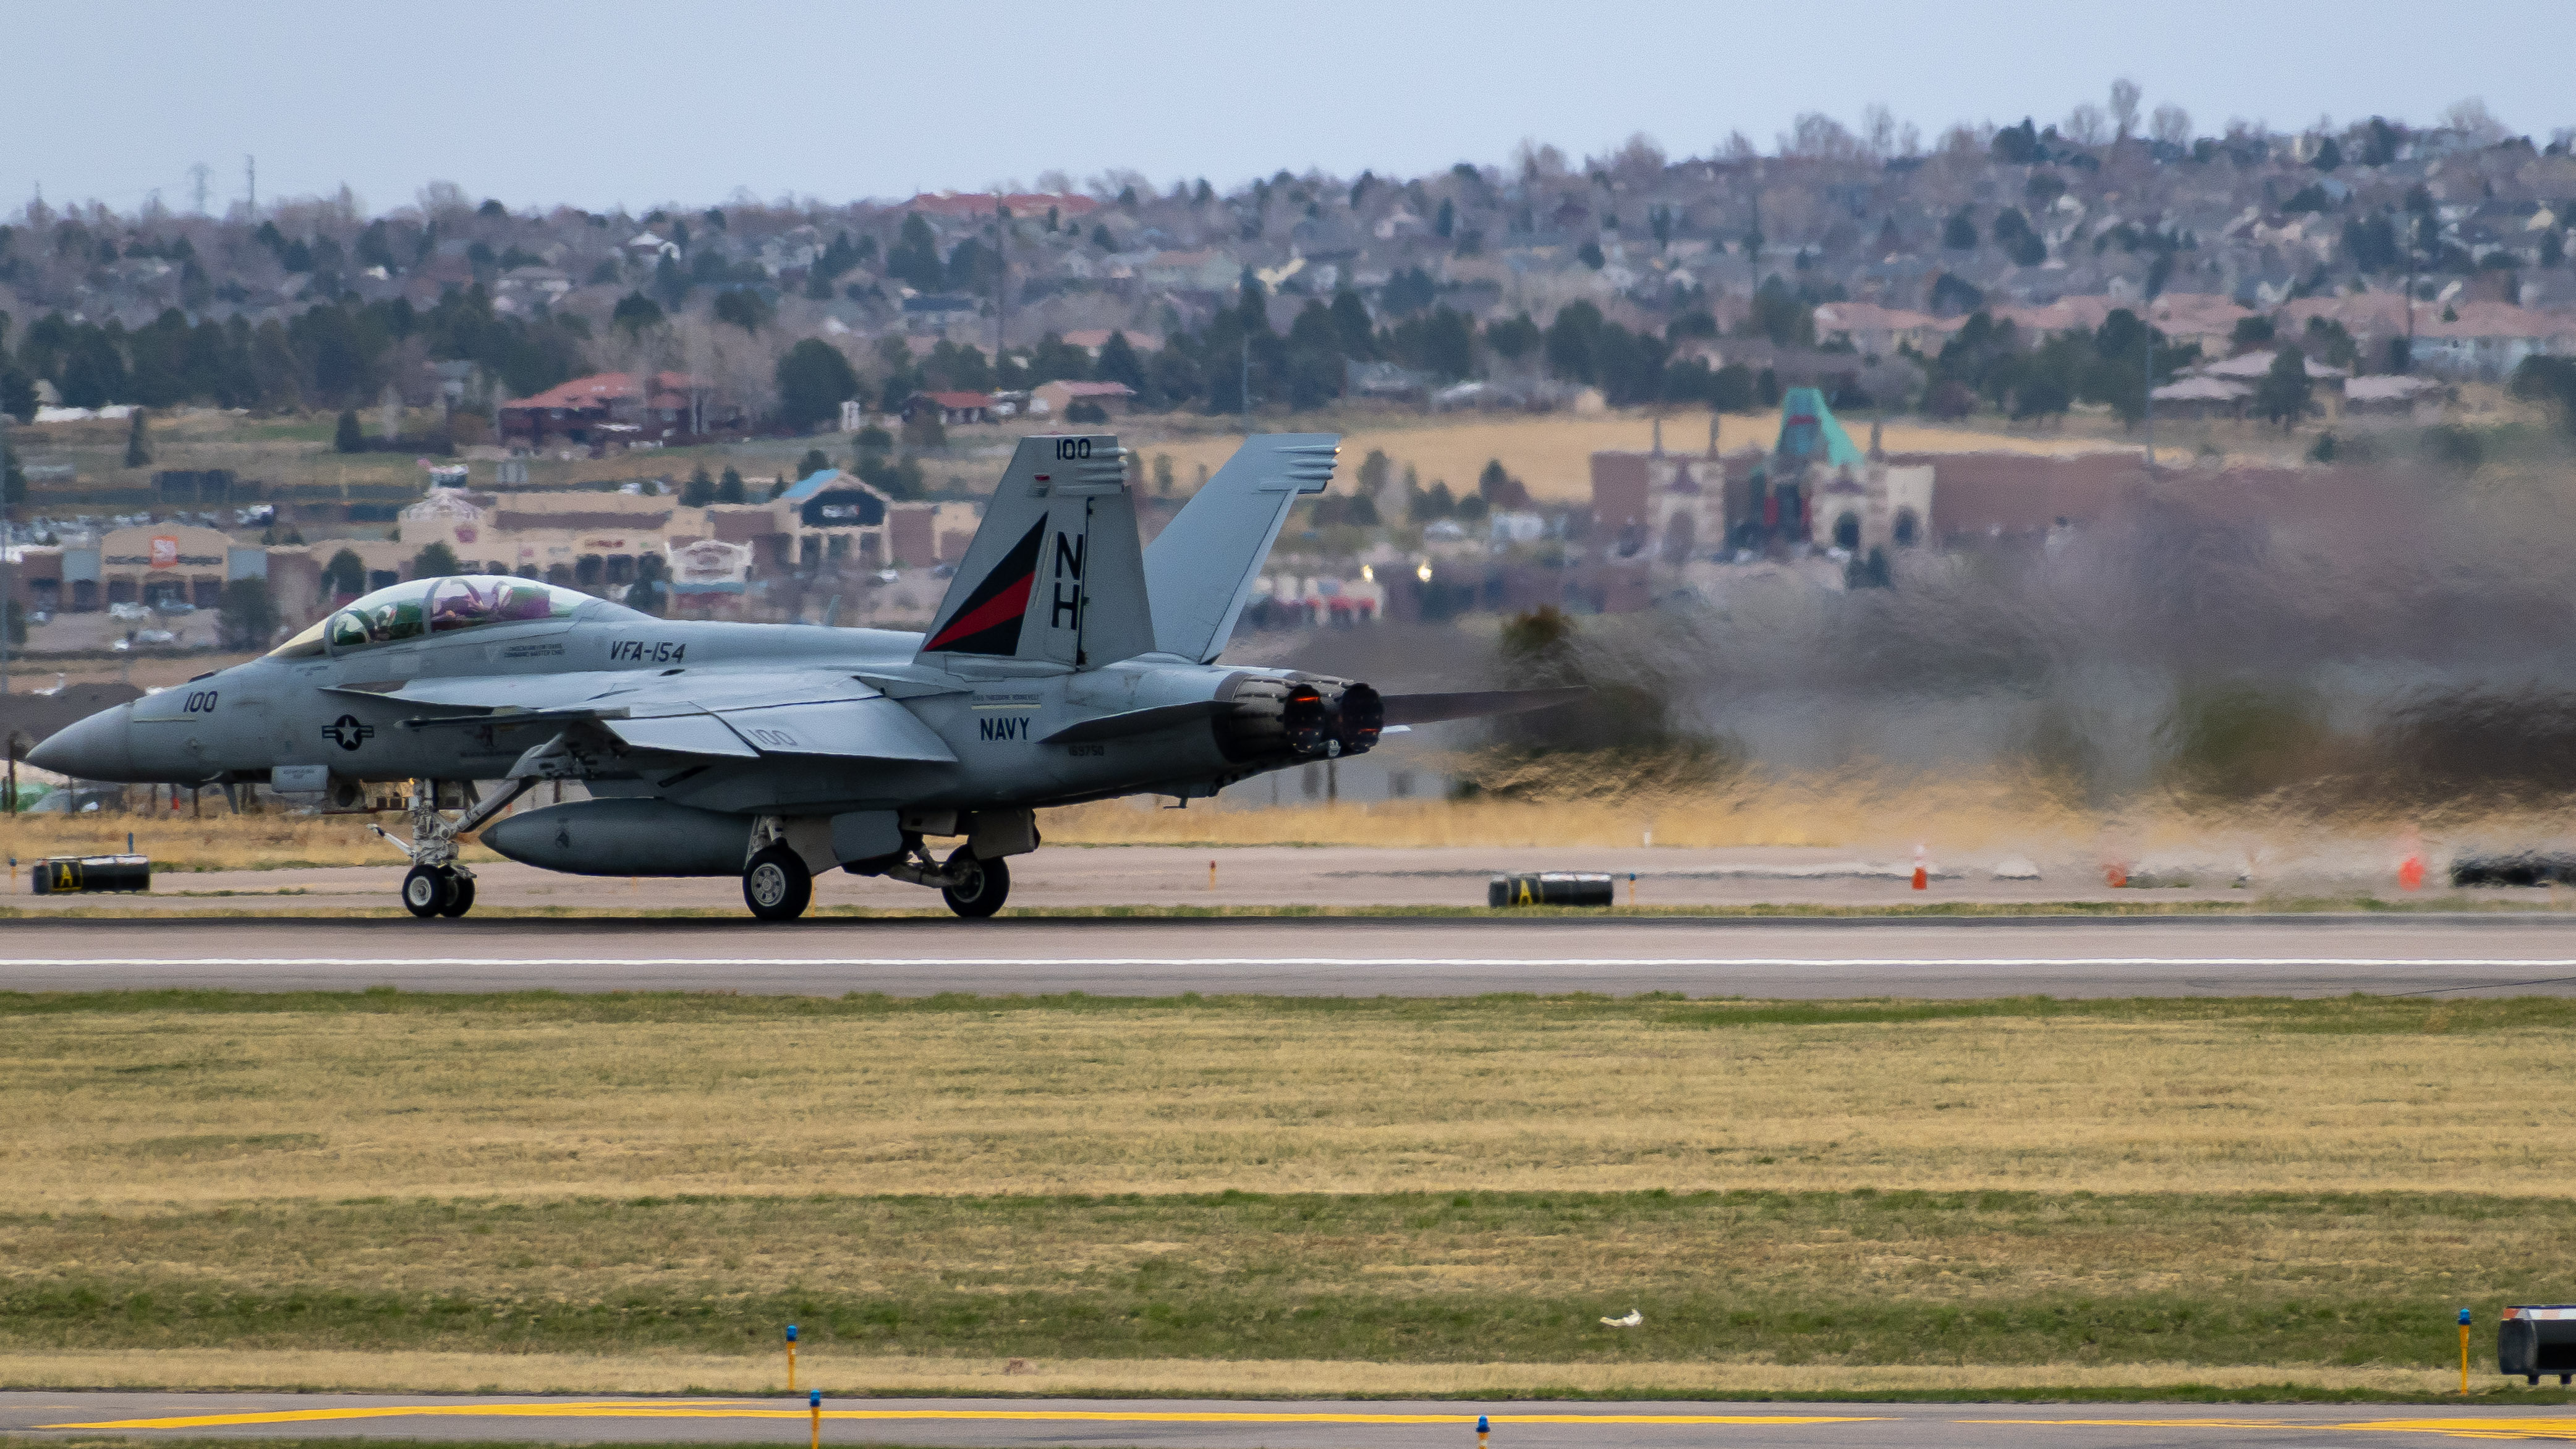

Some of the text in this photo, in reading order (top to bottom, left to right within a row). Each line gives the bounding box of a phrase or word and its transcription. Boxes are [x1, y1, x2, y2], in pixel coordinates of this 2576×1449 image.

[1056, 438, 1091, 460] 100
[610, 640, 686, 663] VFA-154
[183, 691, 218, 713] 100
[747, 729, 798, 746] 100
[980, 717, 1031, 741] NAVY
[1068, 745, 1104, 756] 169750
[60, 864, 73, 887] A
[1519, 879, 1533, 906] A
